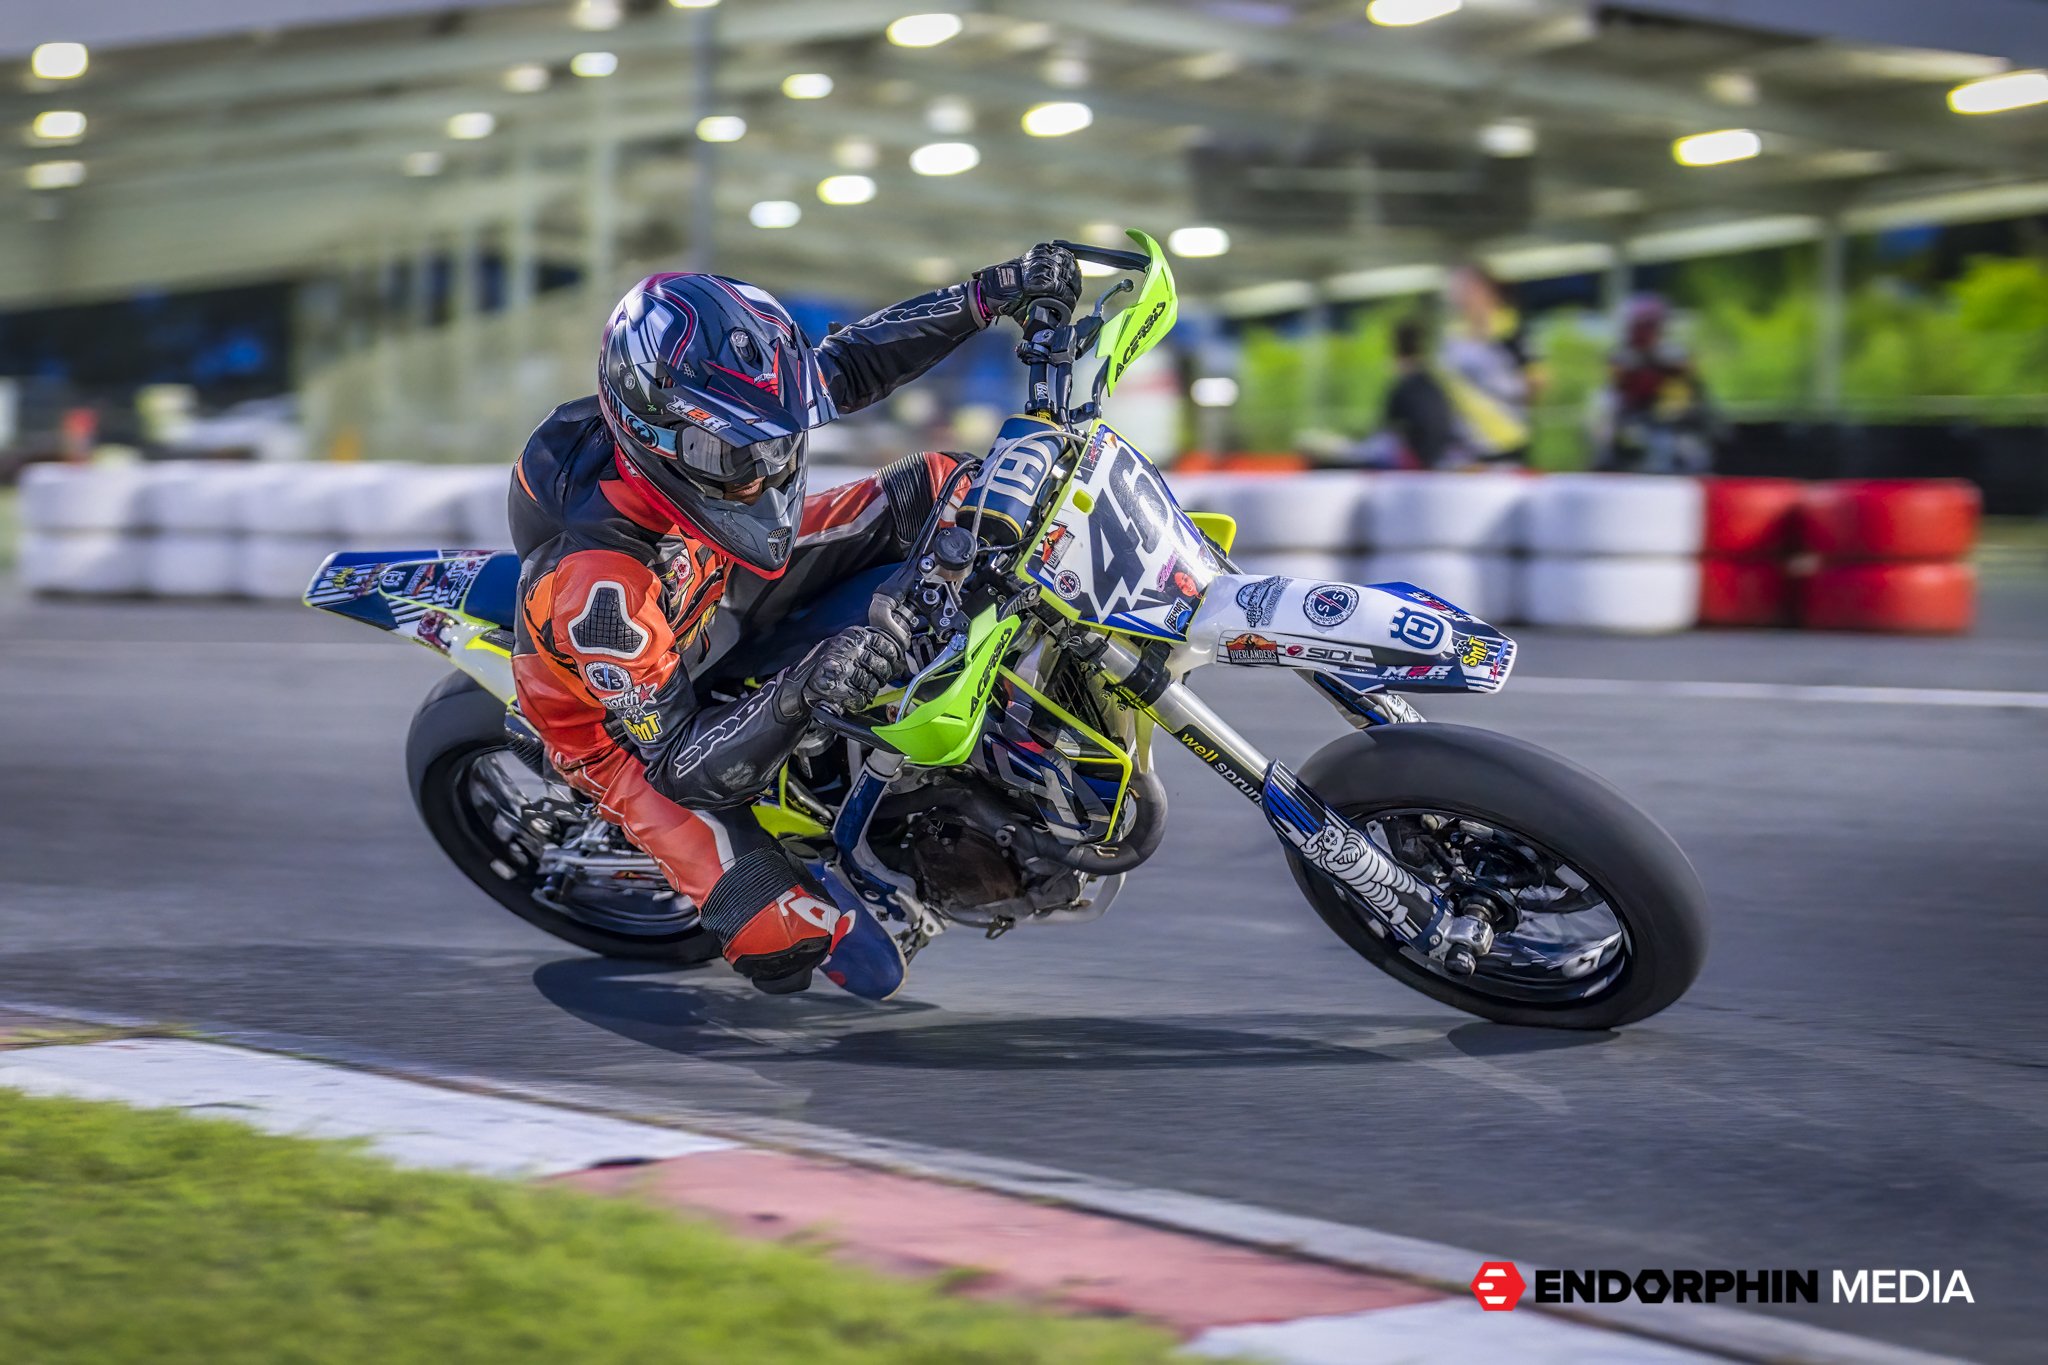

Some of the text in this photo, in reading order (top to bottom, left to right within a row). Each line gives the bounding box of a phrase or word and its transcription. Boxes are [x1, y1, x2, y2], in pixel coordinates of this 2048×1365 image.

[1088, 446, 1170, 611] 46
[1230, 649, 1277, 661] OVERLANDERS
[1462, 635, 1488, 667] SMT
[603, 690, 640, 709] north
[622, 713, 660, 742] SMT
[1181, 733, 1219, 762] well
